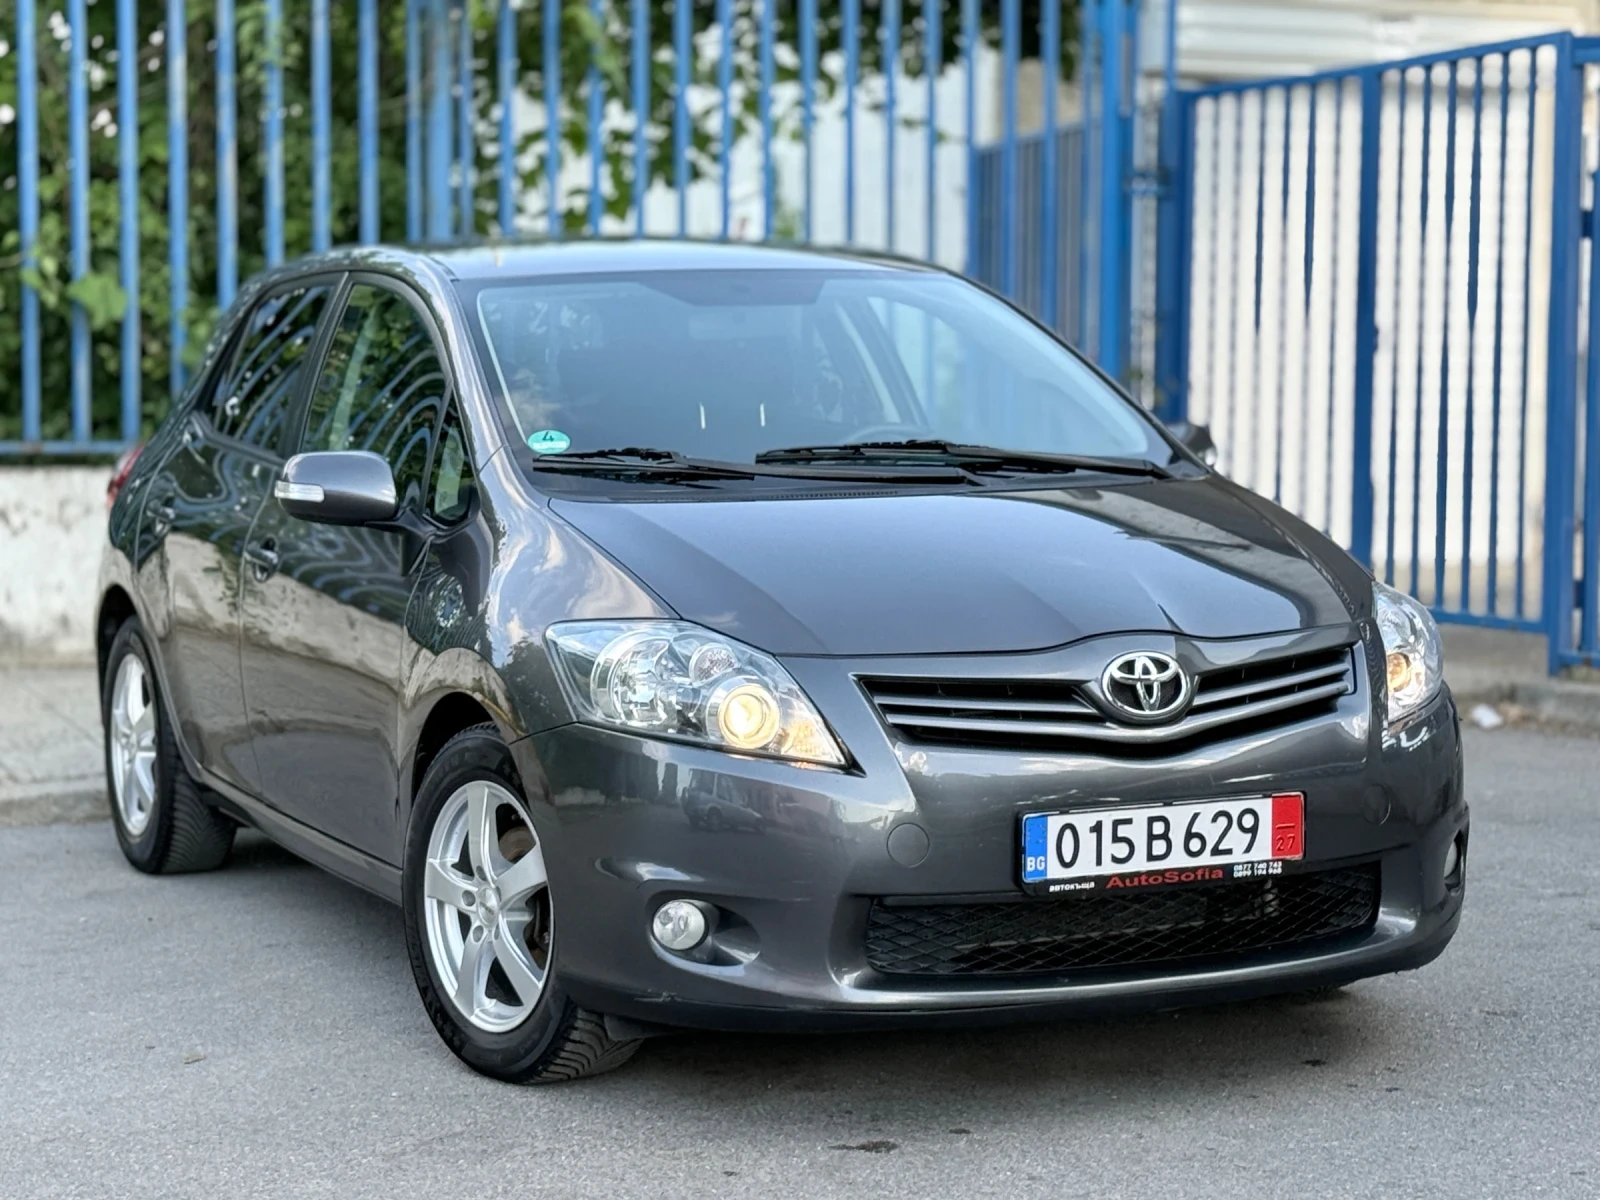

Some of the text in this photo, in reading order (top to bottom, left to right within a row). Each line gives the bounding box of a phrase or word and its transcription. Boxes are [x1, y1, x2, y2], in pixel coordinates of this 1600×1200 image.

[542, 431, 555, 442] 4
[1055, 807, 1260, 869] 015 B 629
[1275, 834, 1296, 852] 27
[1026, 855, 1046, 872] BG
[1105, 868, 1224, 889] AutoSofia
